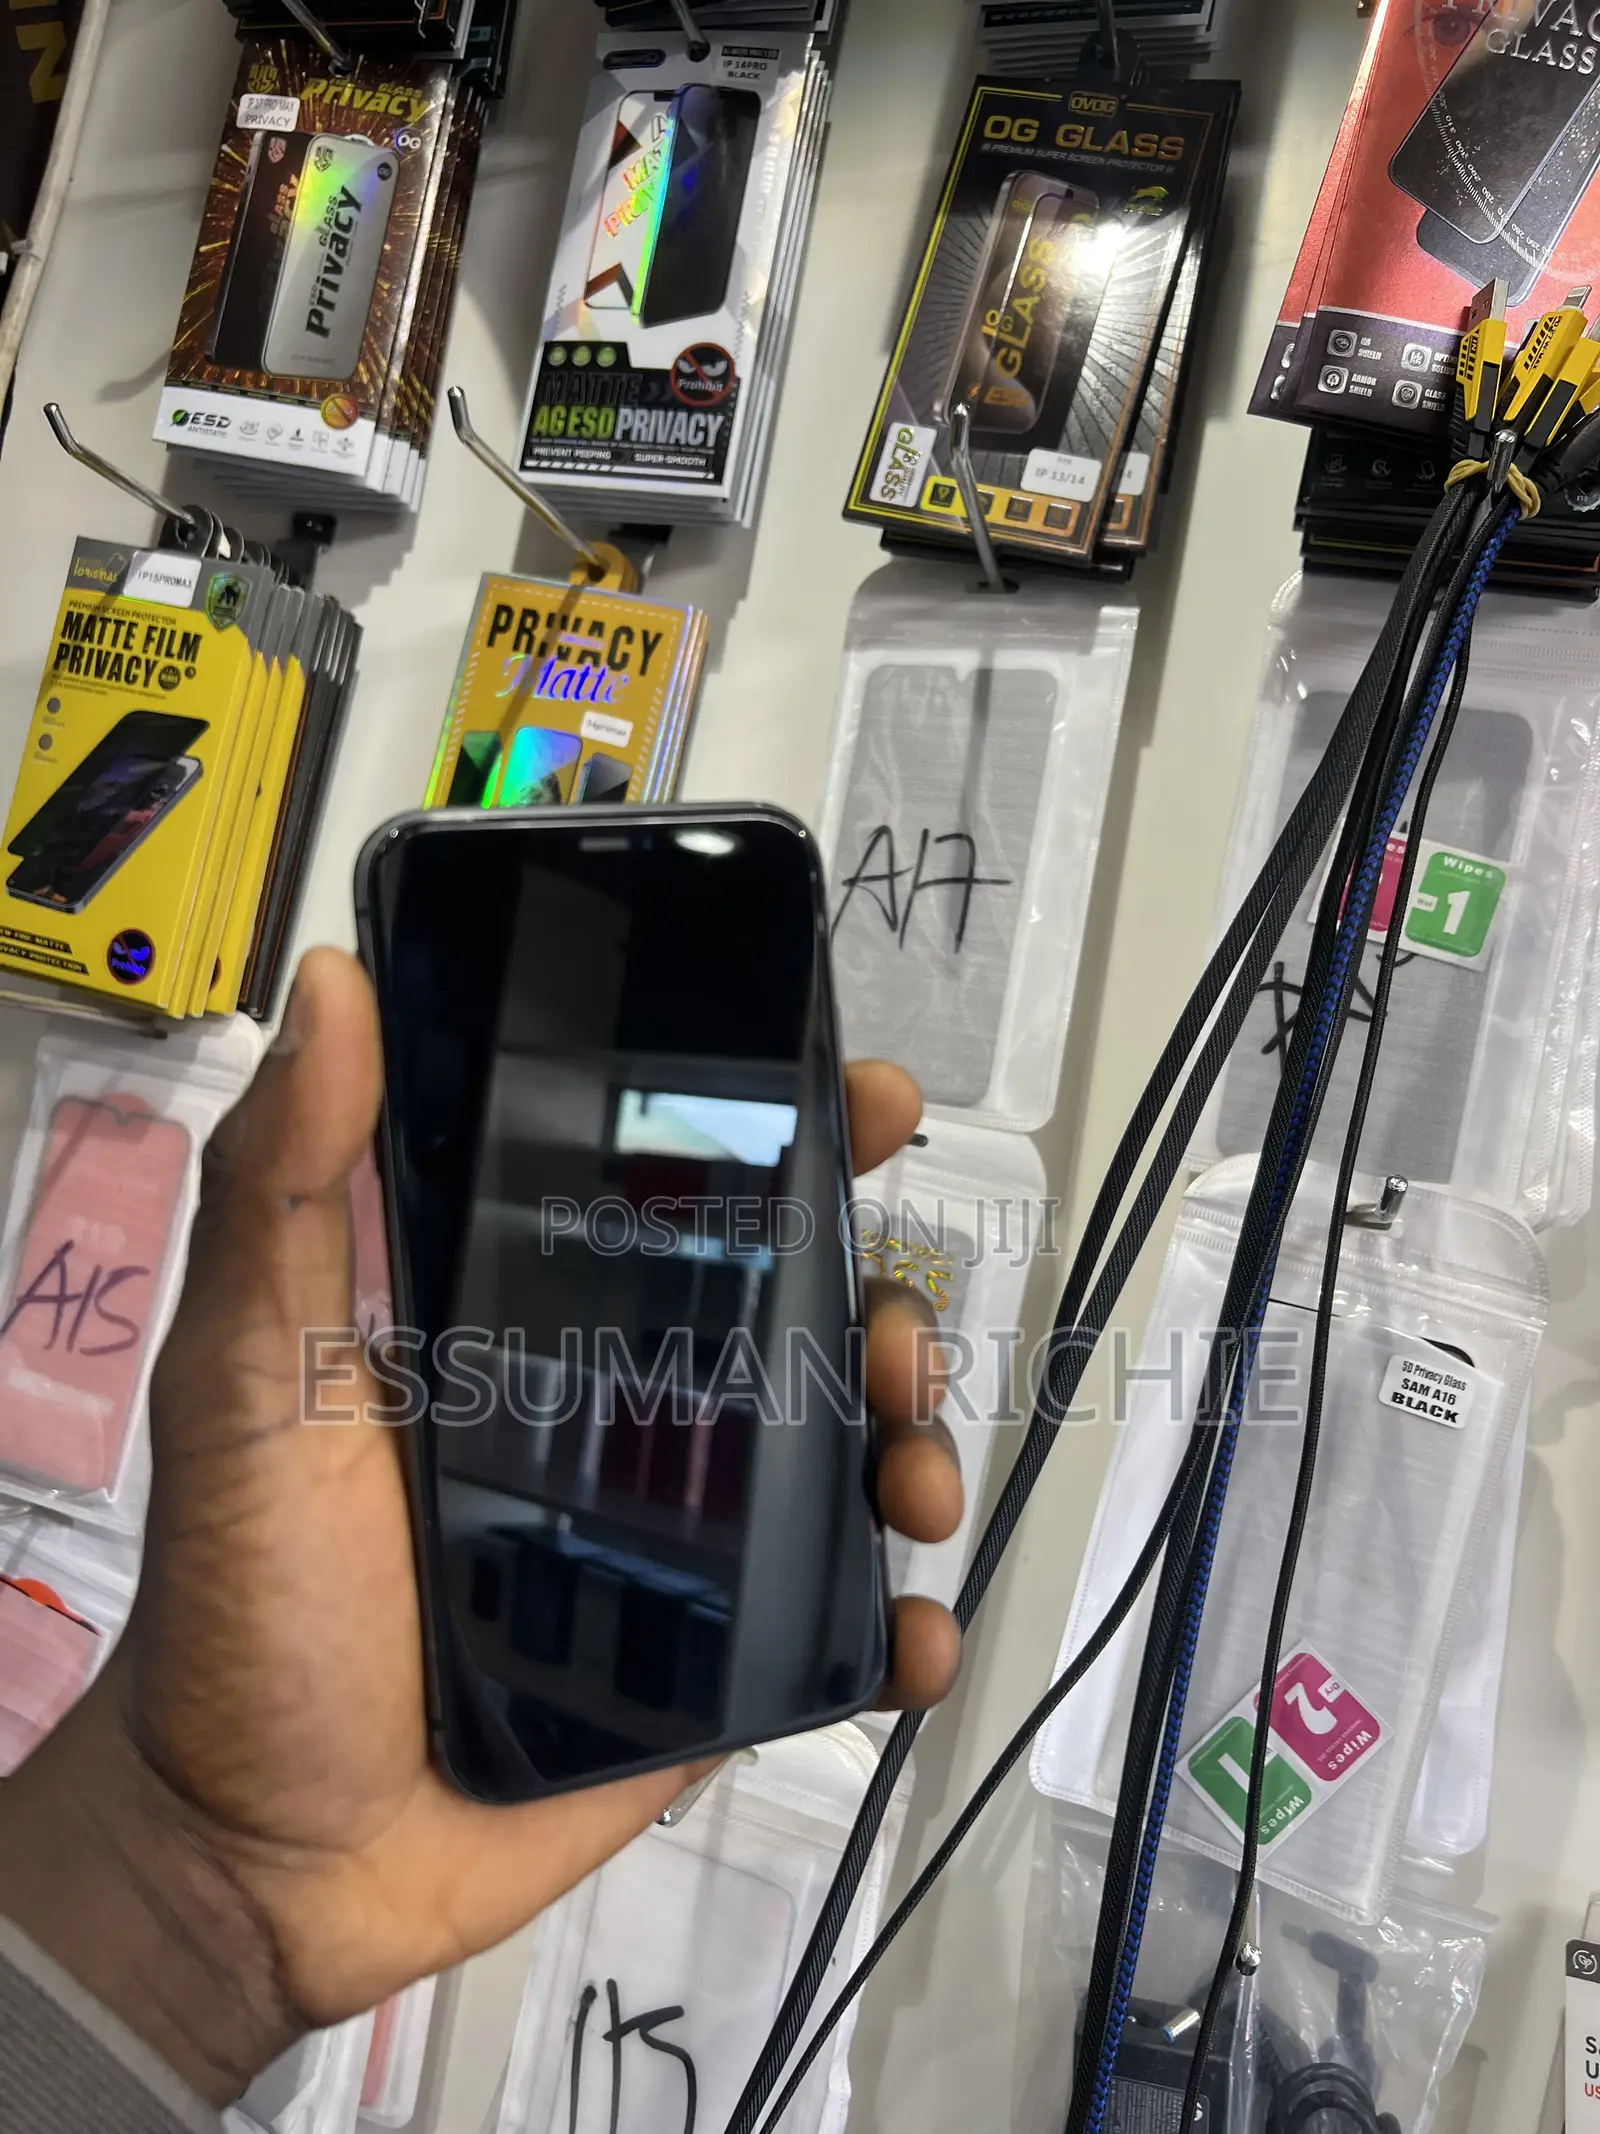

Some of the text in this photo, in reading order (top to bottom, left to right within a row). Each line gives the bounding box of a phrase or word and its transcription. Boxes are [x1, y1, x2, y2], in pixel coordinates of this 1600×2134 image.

[1486, 27, 1598, 75] GLASS
[300, 77, 428, 123] Privacy
[245, 114, 291, 127] PRIVACY
[983, 115, 1186, 161] OG GLASS
[1349, 385, 1373, 397] SHIELD
[1351, 373, 1377, 386] ARMOR
[190, 412, 231, 429] ESD
[68, 600, 177, 626] PREMIUM SCREEN PROTECTOR
[61, 610, 203, 665] MATTE FILM
[487, 603, 664, 677] PRIVACY
[53, 641, 160, 689] PRIVACY
[1443, 856, 1494, 879] Wipes
[1401, 1378, 1457, 1406] SAM A16
[1414, 1365, 1444, 1385] Privacy
[1444, 1374, 1467, 1391] Glass
[1391, 1391, 1460, 1424] BLACK
[1323, 1680, 1341, 1696] Dry
[1283, 1681, 1338, 1735] 2
[1328, 1730, 1373, 1771] Wipes
[1261, 1795, 1305, 1835] Wipes
